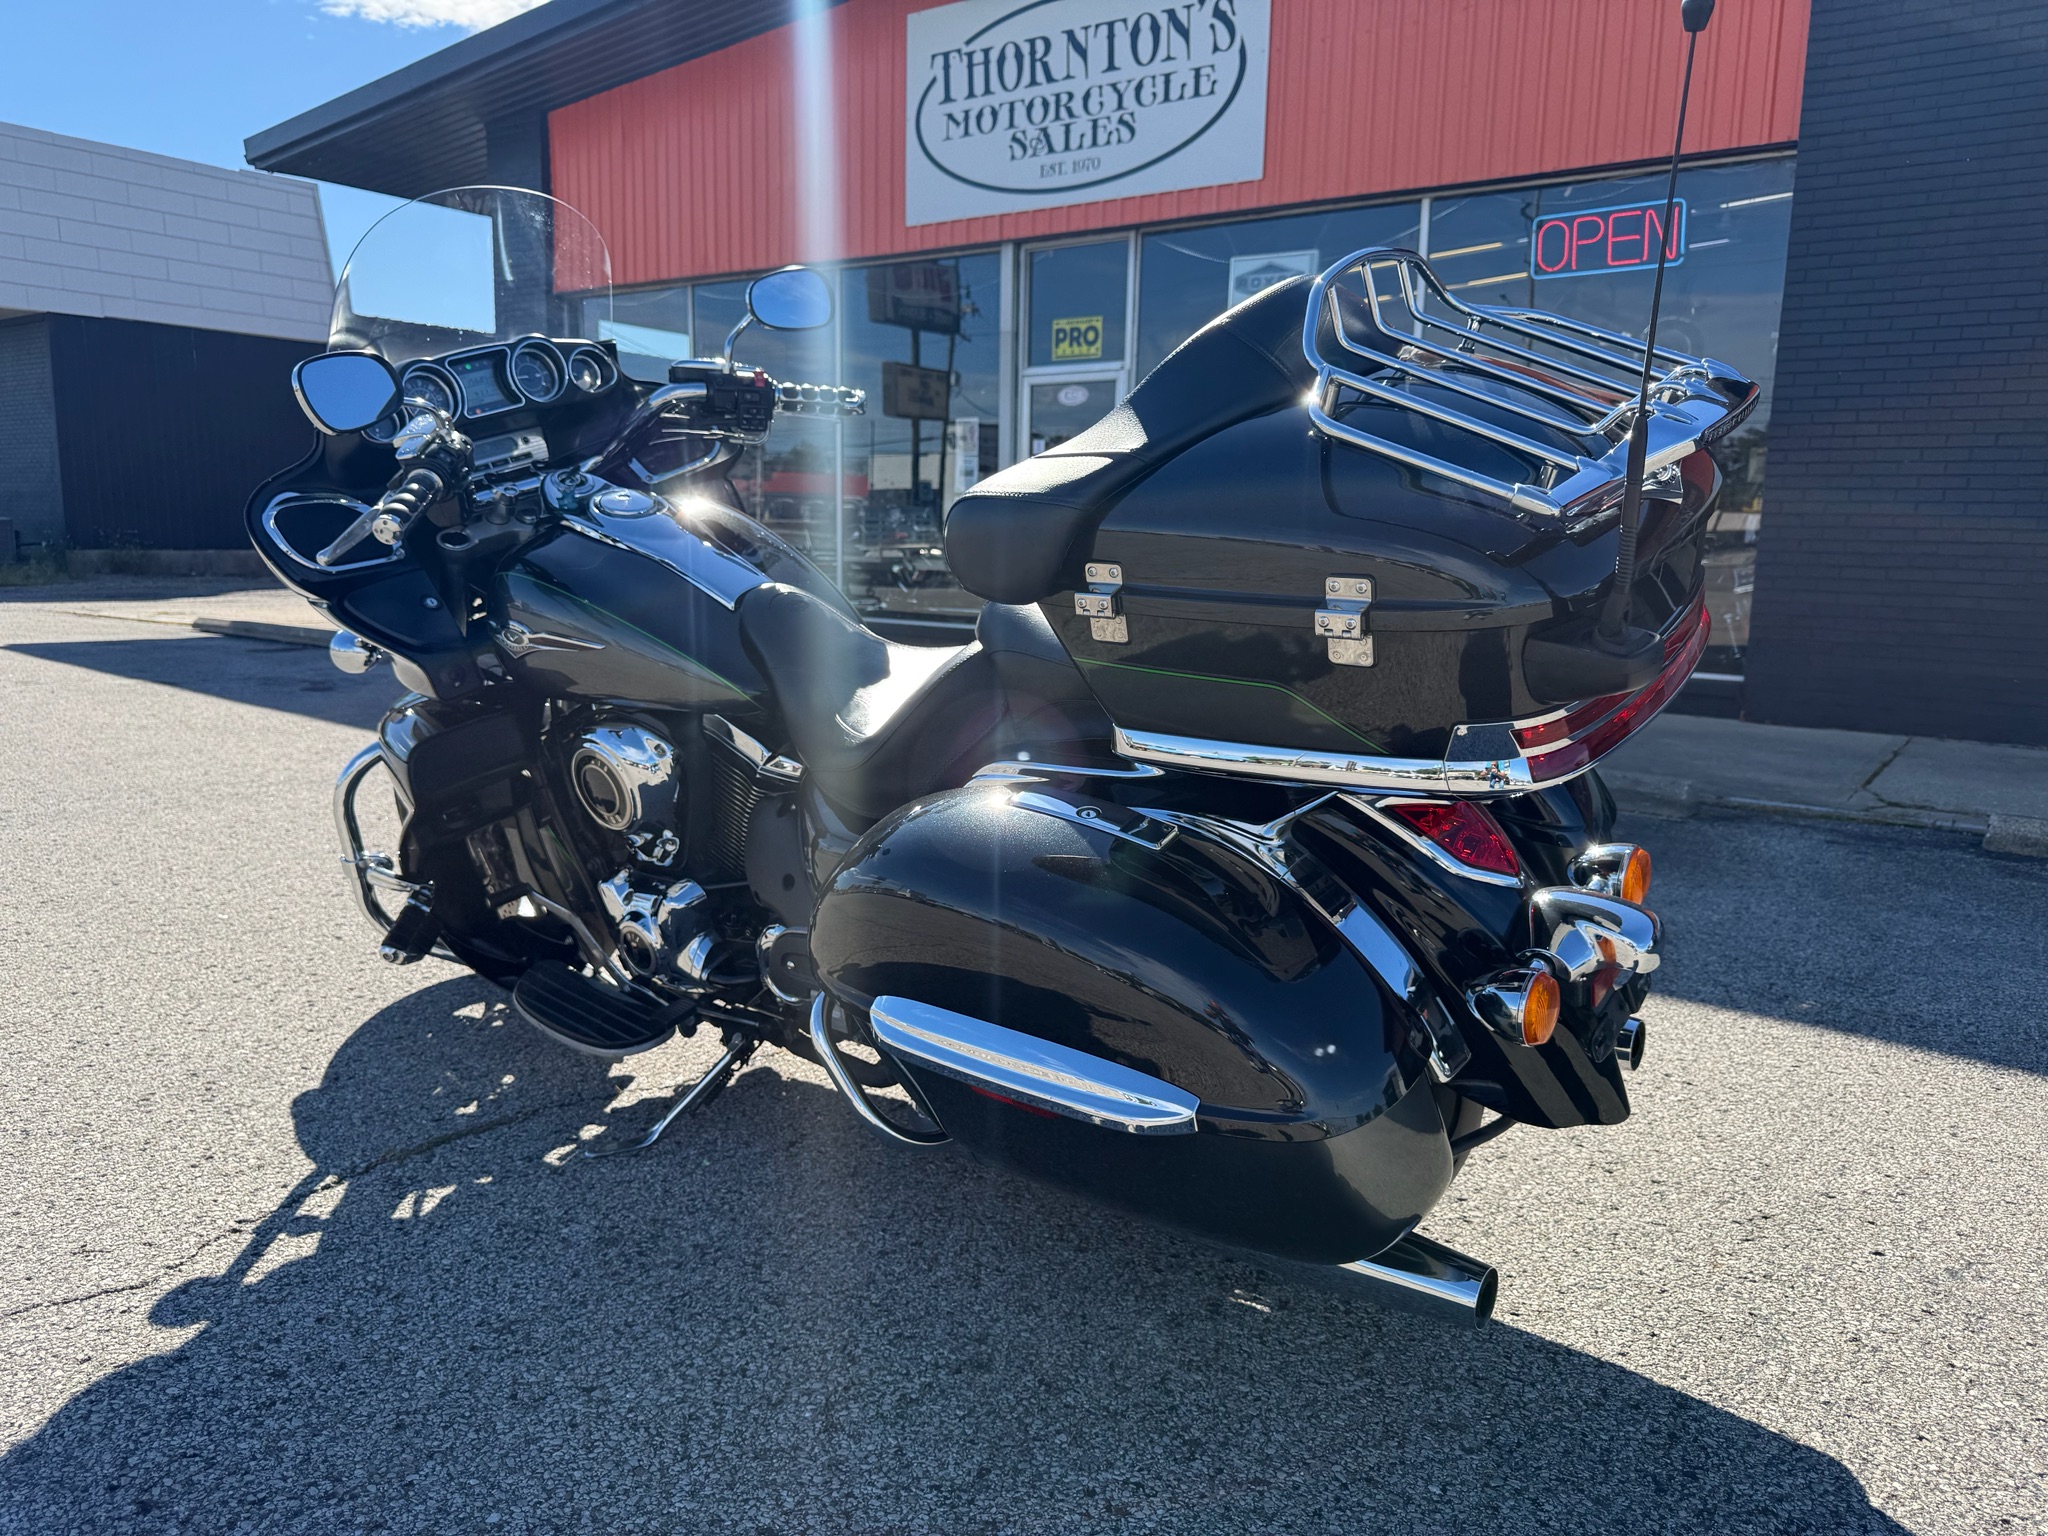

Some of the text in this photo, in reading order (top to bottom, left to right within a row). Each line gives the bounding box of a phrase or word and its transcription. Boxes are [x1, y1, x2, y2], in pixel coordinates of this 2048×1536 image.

[930, 0, 1237, 105] THORNTON'S
[942, 64, 1218, 142] MOTORCYCLE
[1008, 111, 1137, 161] SALES
[1040, 157, 1102, 178] EST. 1970
[1537, 206, 1680, 272] OPEN
[1055, 325, 1100, 349] PRO
